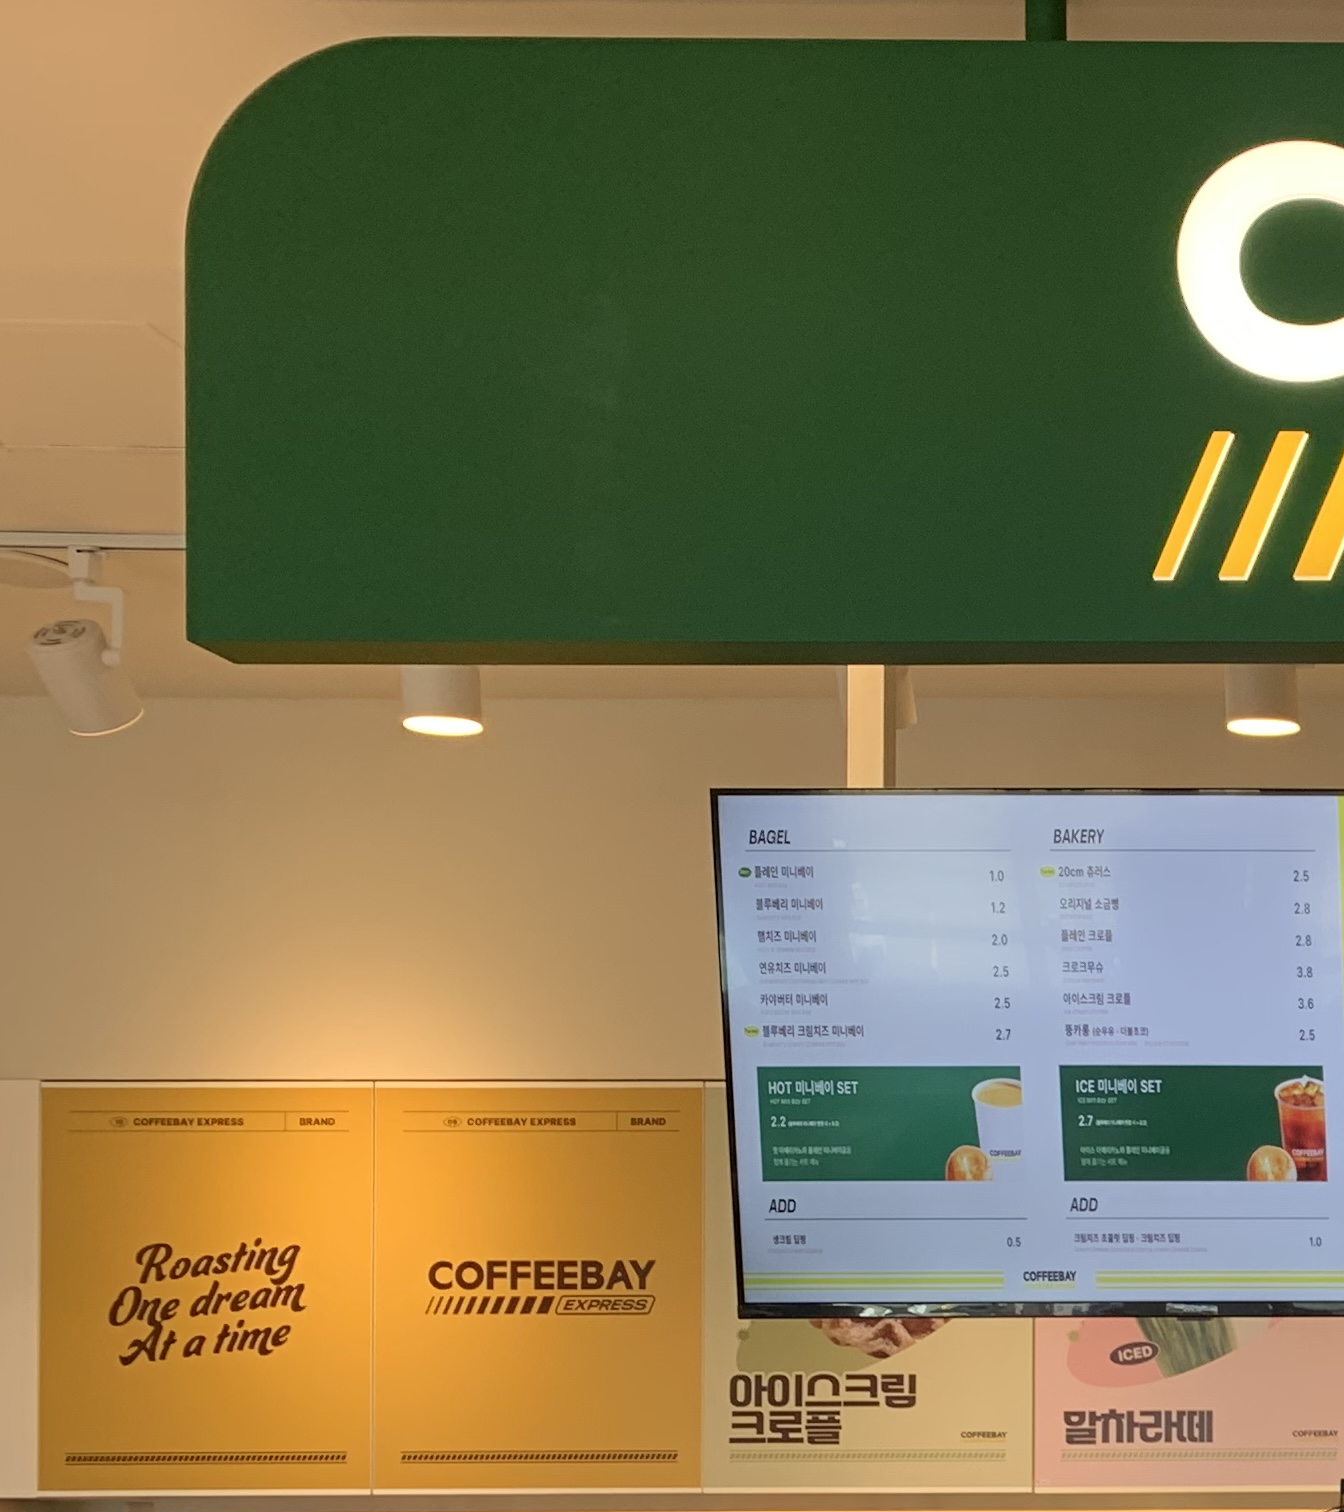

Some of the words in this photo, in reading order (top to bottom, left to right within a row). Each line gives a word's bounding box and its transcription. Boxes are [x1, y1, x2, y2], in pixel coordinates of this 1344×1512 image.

[749, 830, 790, 845] BAGEL
[1053, 829, 1105, 844] BAKERY
[768, 1081, 792, 1095] HOT
[795, 1080, 834, 1095] 미니베이
[837, 1081, 858, 1094] SET
[1076, 1080, 1095, 1093] ICE
[1098, 1079, 1137, 1094] 미니베이
[1140, 1079, 1162, 1093] SET
[133, 1118, 195, 1126] COFFEEBAY
[197, 1118, 244, 1126] EXPRESS
[299, 1118, 335, 1126] BRAND
[466, 1117, 526, 1126] COFFEEBAY
[530, 1117, 576, 1126] EXPRESS
[630, 1117, 666, 1126] BRAND
[769, 1199, 797, 1213] ADD
[1070, 1197, 1098, 1212] ADD
[136, 1237, 301, 1285] Roasting
[429, 1260, 656, 1291] COFFEEBAY
[1023, 1270, 1077, 1283] COFFEEBAY
[109, 1286, 180, 1327] One
[190, 1280, 306, 1317] dream
[564, 1298, 648, 1312] EXPRESS
[119, 1322, 177, 1366] At
[183, 1335, 206, 1358] a
[213, 1319, 291, 1356] time
[1117, 1345, 1153, 1361] ICED
[729, 1373, 917, 1409] 아이스크림
[729, 1410, 843, 1445] 크로플
[960, 1430, 1007, 1439] COFFEEBAY
[1063, 1409, 1214, 1445] 말차라떼
[1292, 1429, 1338, 1438] COFFEEBAY
